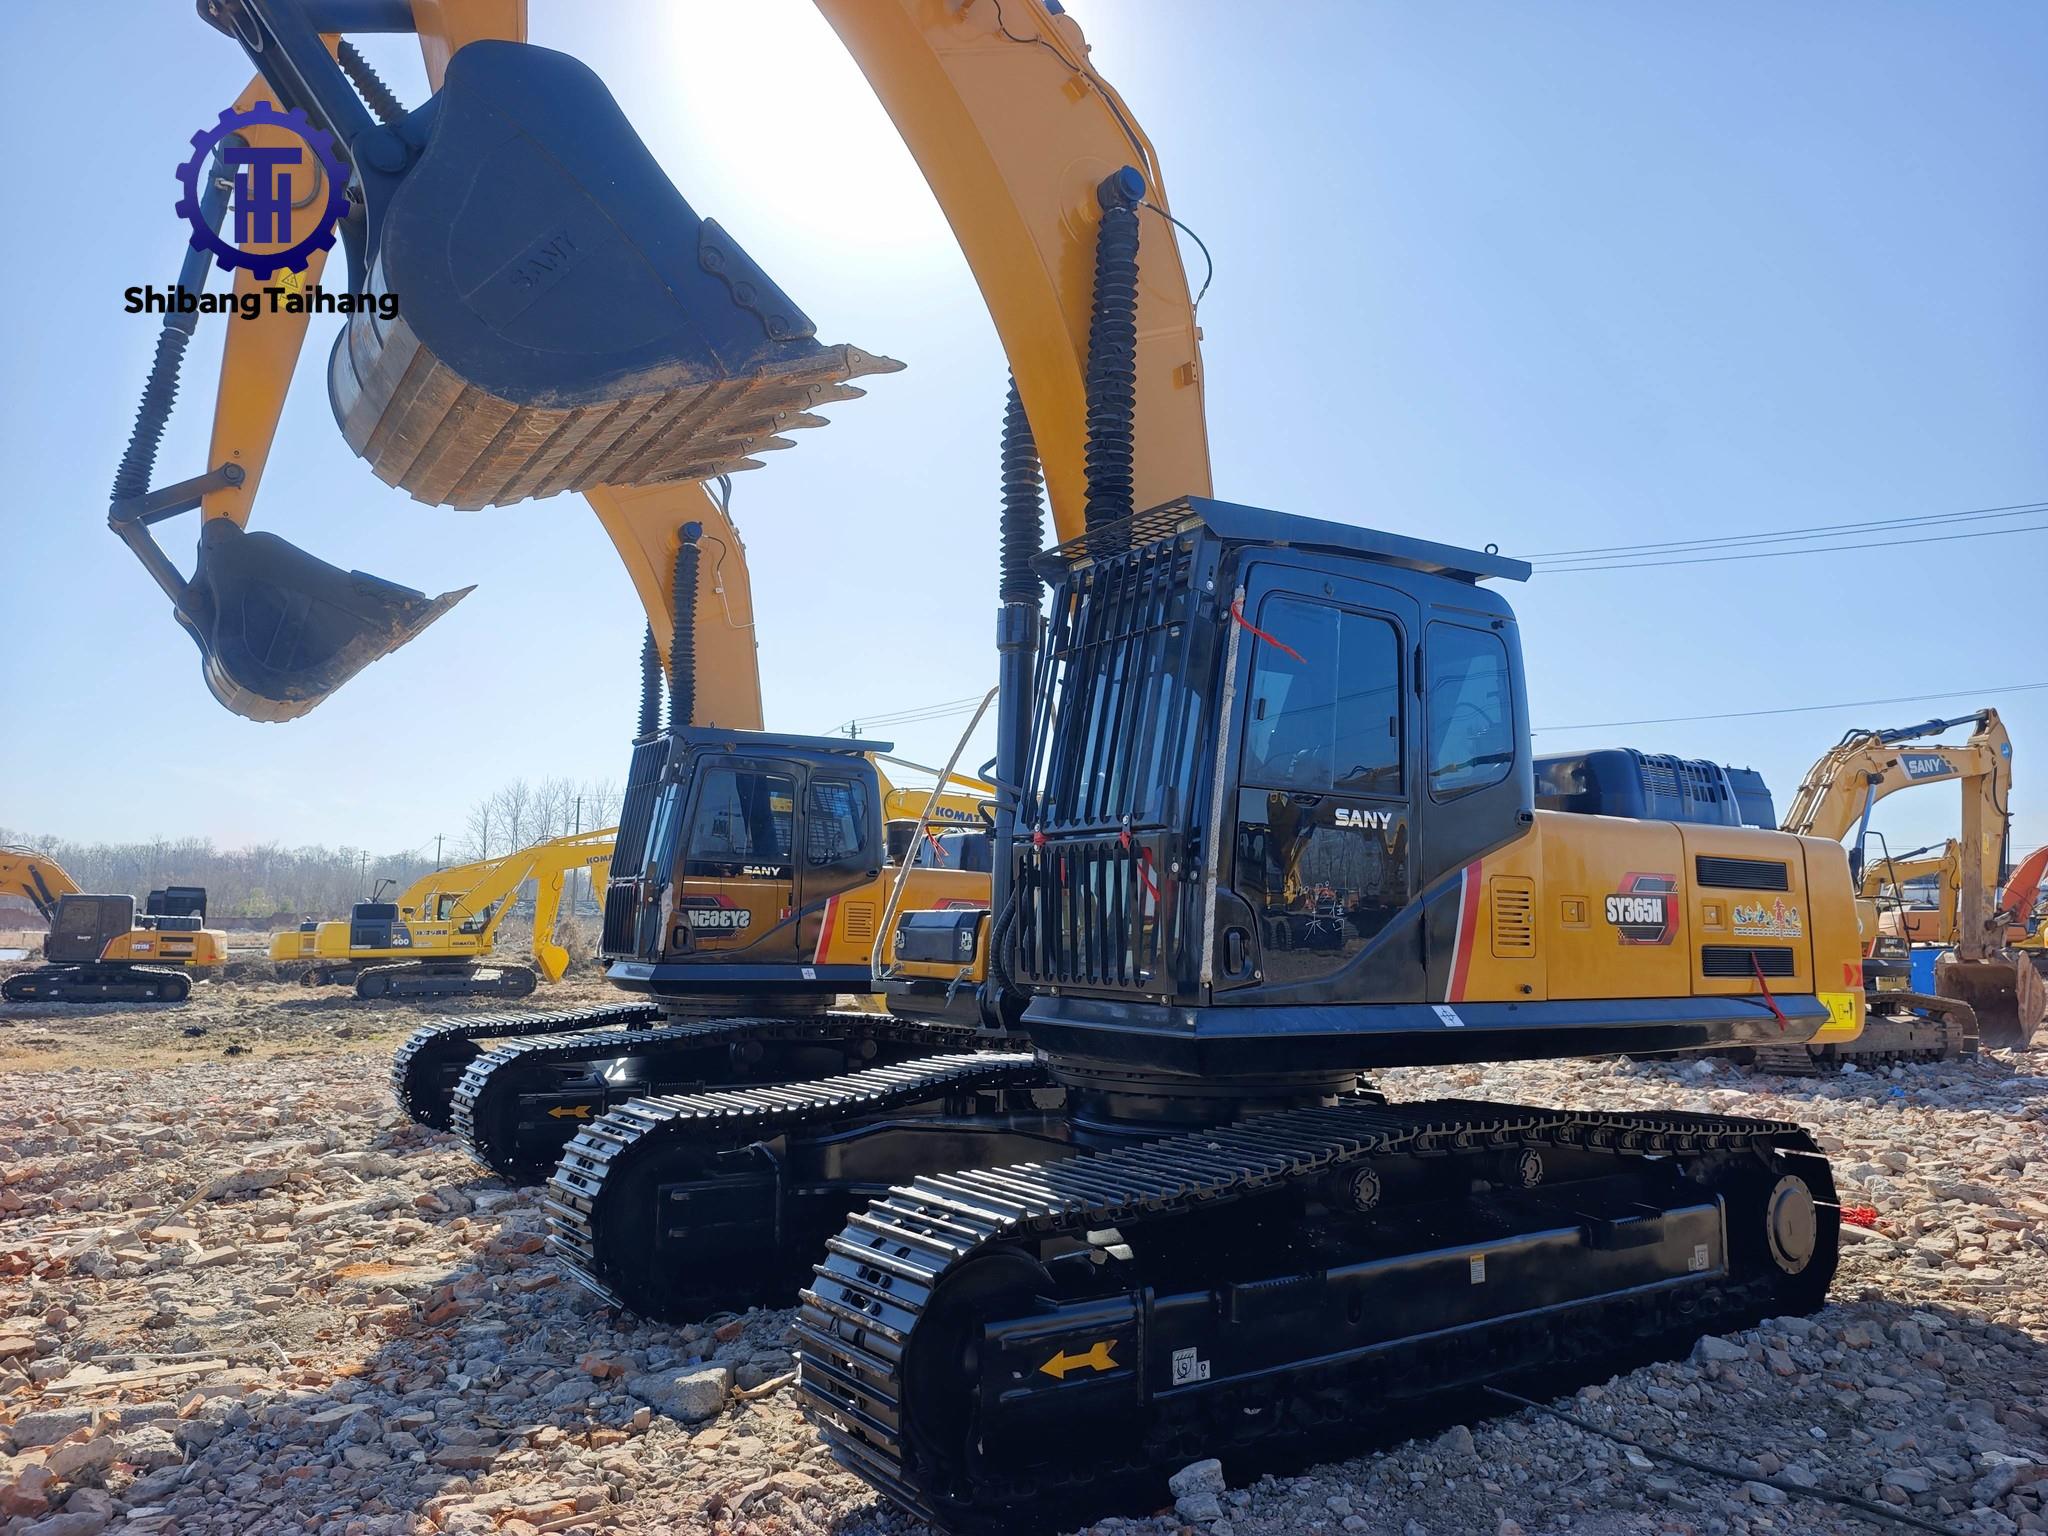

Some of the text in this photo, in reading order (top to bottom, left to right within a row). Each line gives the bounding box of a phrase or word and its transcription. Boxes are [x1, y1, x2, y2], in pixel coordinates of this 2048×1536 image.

[1908, 758, 1940, 774] SANY
[935, 806, 982, 822] KOMAT
[1335, 808, 1392, 829] SANY
[743, 865, 780, 876] SANY
[1606, 897, 1663, 923] SY365H
[392, 938, 409, 946] 400
